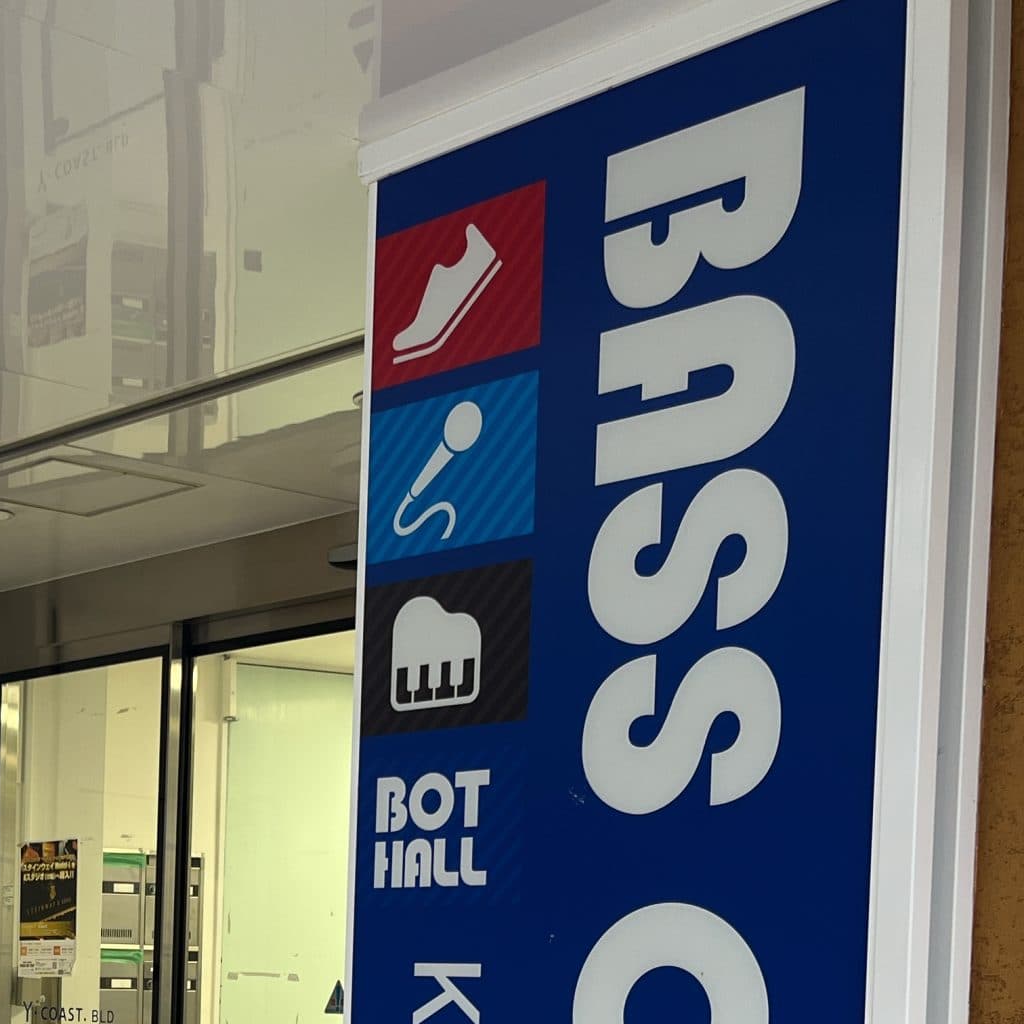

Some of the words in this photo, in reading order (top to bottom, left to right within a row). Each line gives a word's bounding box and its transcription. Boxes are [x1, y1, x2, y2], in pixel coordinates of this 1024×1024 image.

[581, 86, 805, 815] BASS
[375, 769, 491, 833] BOT
[373, 837, 487, 889] HALL
[91, 1010, 114, 1023] BLD
